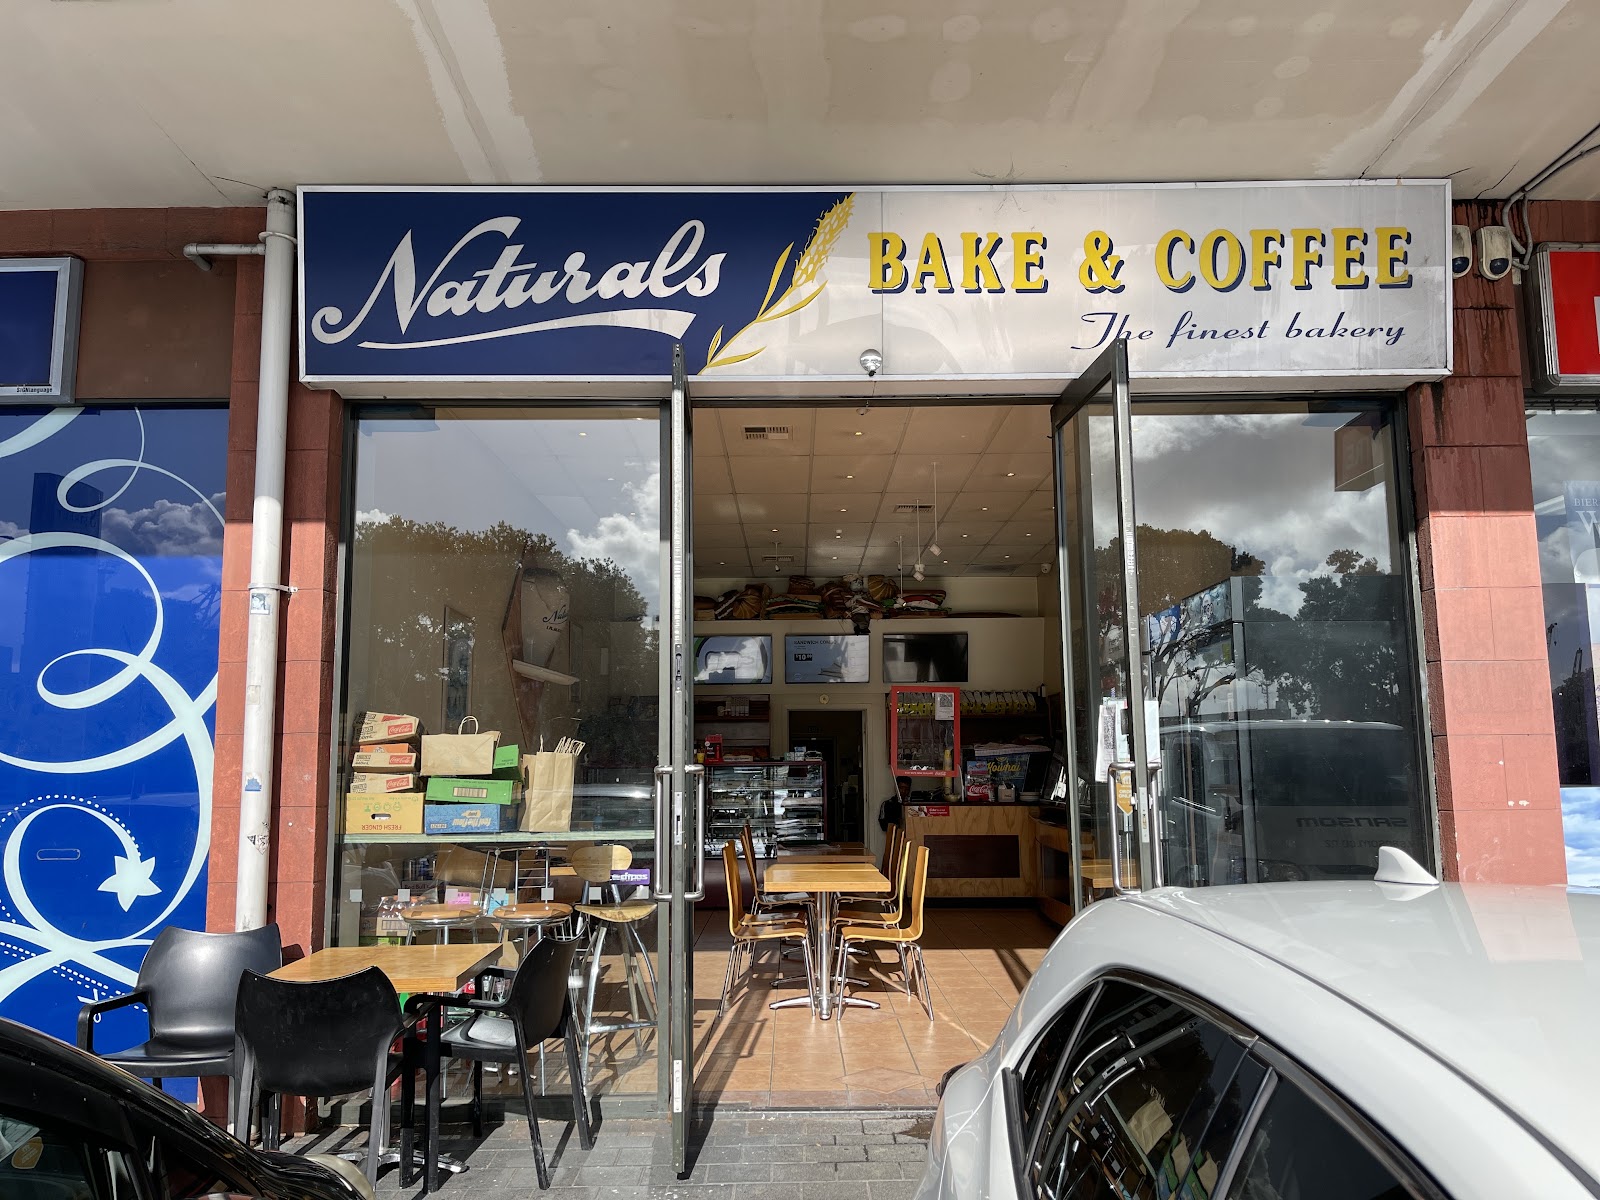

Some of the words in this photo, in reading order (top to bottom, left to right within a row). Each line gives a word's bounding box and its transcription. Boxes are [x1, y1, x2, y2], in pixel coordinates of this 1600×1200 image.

[311, 216, 727, 344] Naturals
[867, 231, 1049, 294] BAKE
[1078, 230, 1126, 294] &
[1154, 226, 1413, 292] COFFEE
[1070, 312, 1155, 350] The
[1166, 311, 1270, 348] finest
[1285, 311, 1406, 346] bakery
